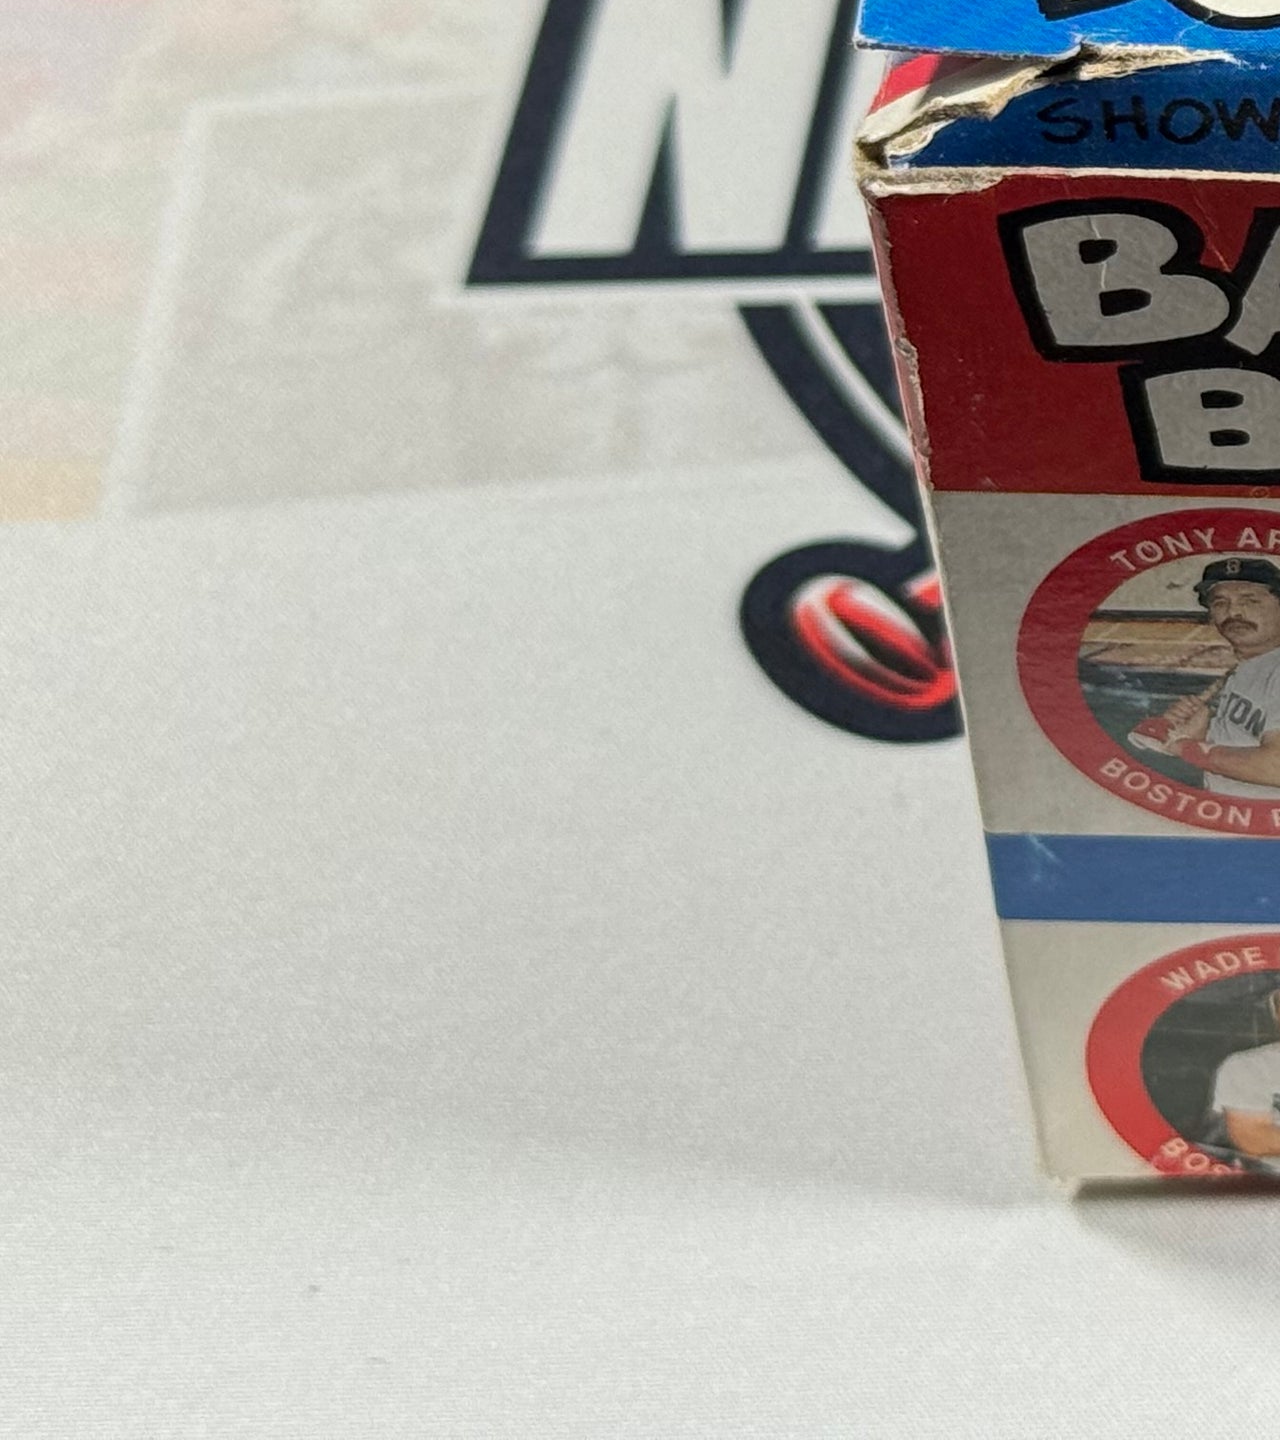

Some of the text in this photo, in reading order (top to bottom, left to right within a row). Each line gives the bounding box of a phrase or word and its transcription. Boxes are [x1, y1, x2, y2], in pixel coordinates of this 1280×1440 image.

[1110, 527, 1217, 574] TONY
[1100, 758, 1252, 829] BOSTON
[1160, 944, 1263, 993] WADE
